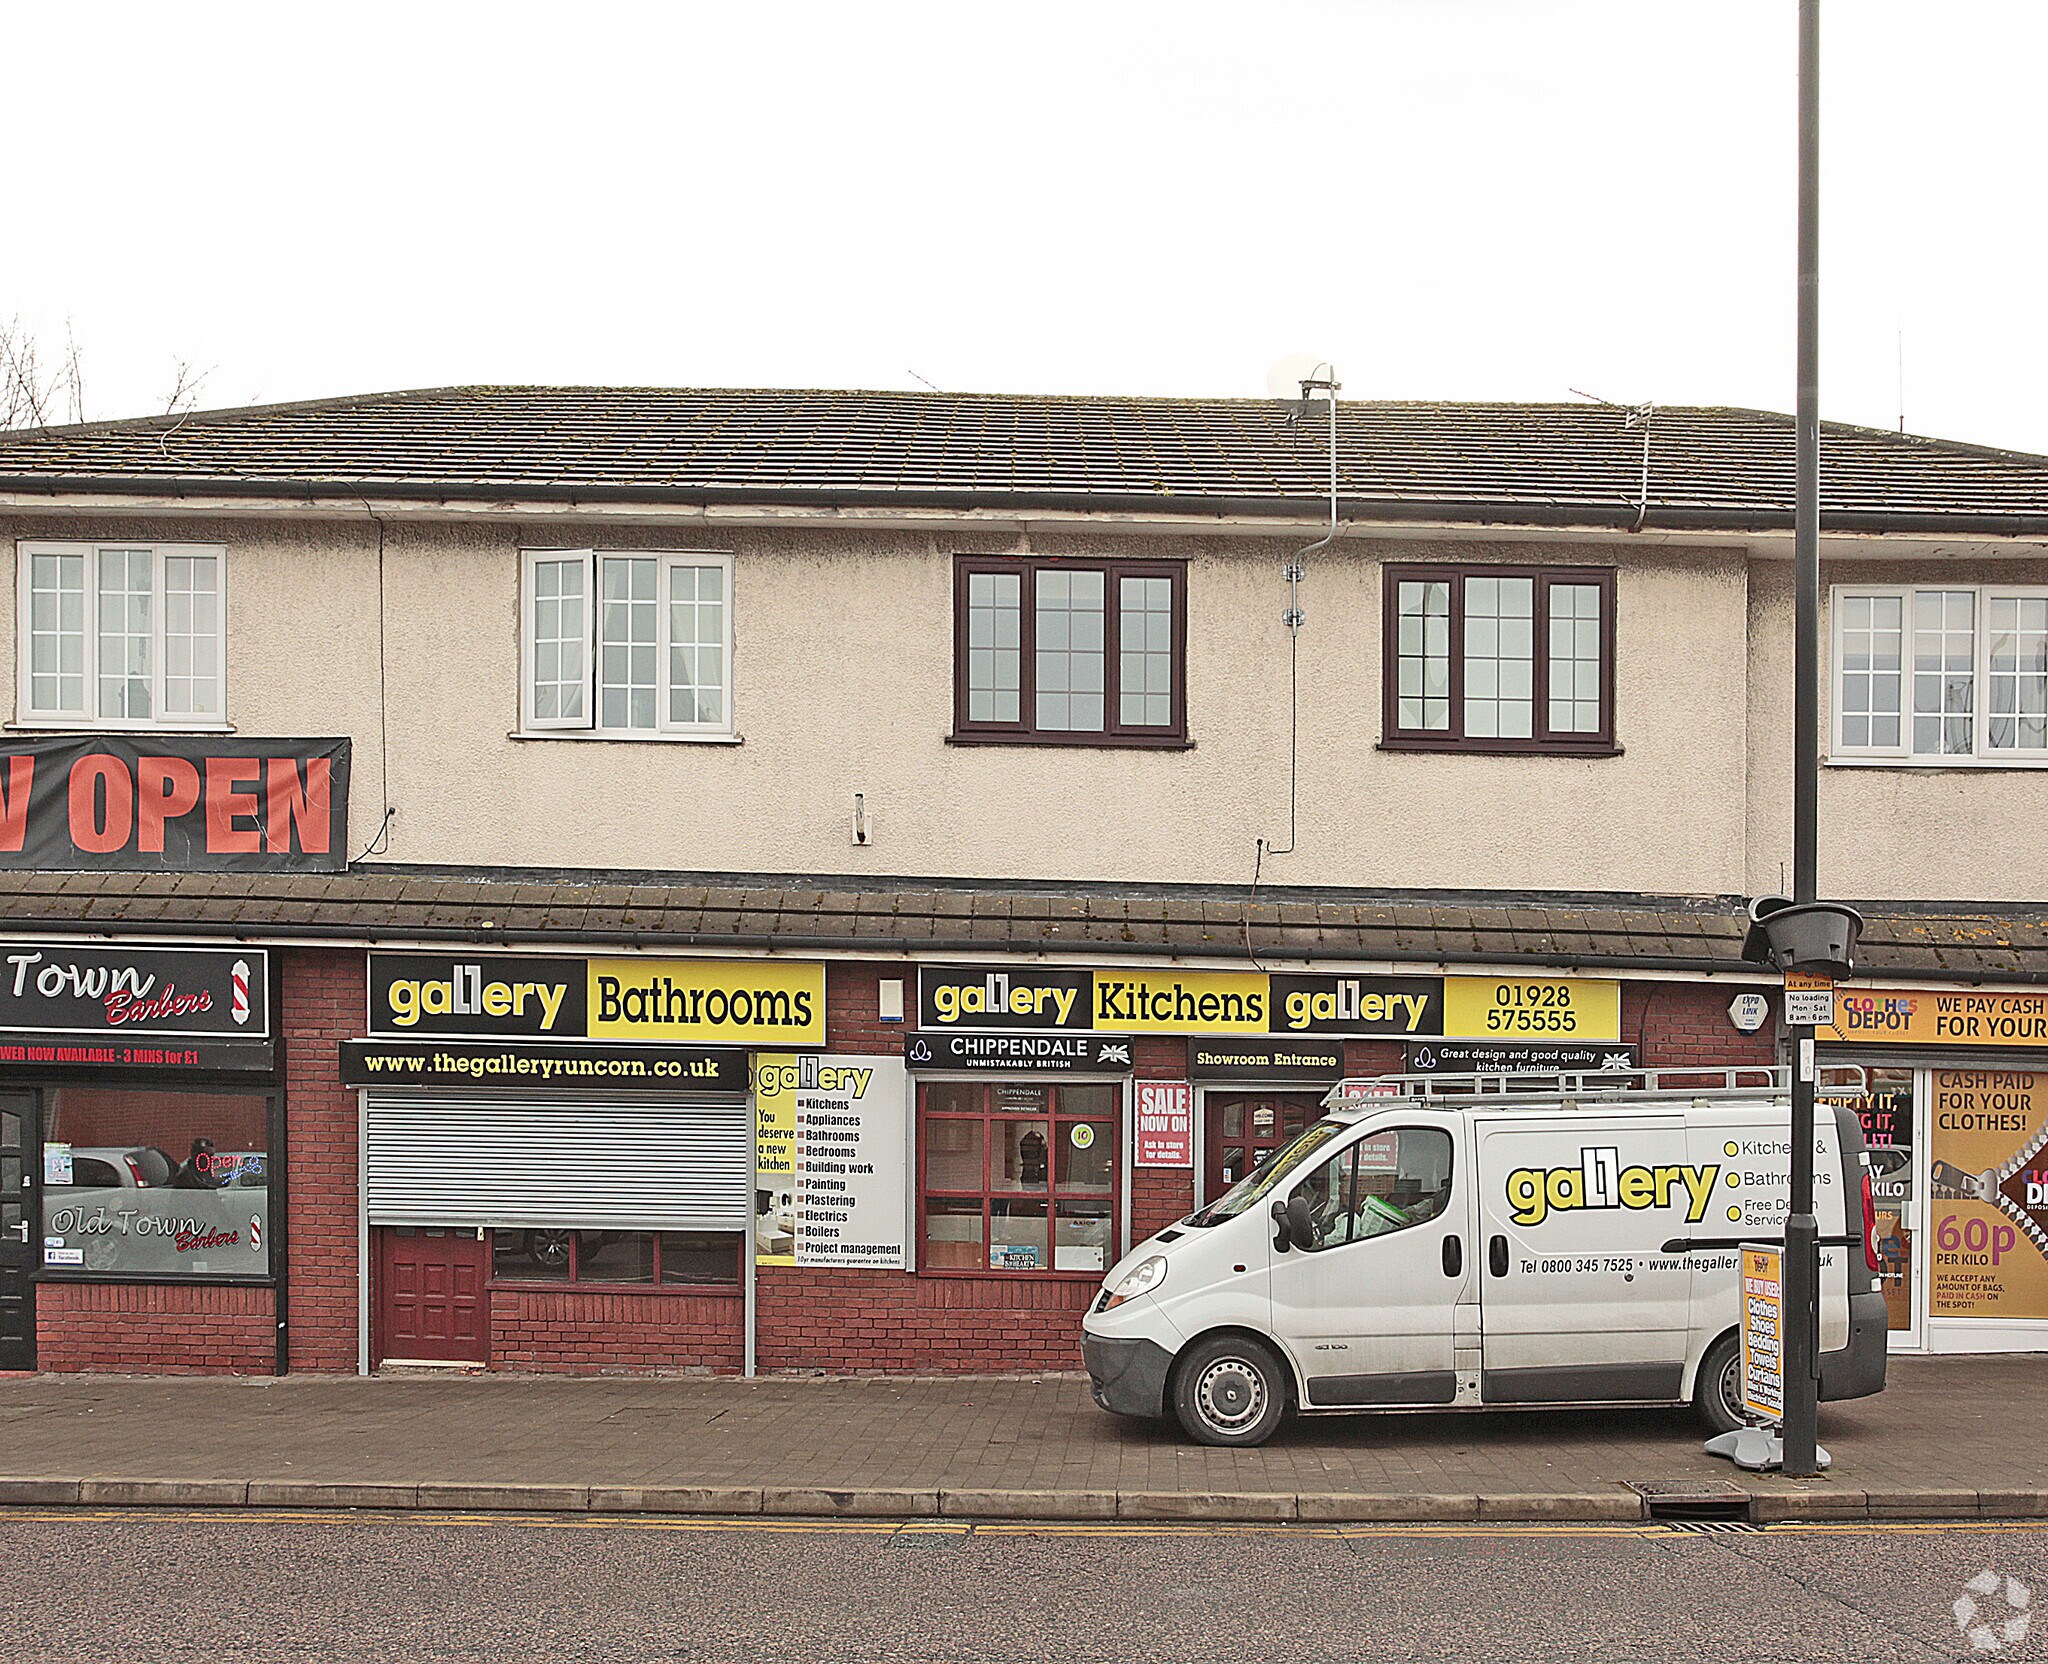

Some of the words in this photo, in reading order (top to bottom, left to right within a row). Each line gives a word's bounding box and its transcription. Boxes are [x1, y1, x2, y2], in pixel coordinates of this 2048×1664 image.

[68, 753, 331, 853] OPEN
[7, 951, 155, 999] Town
[104, 982, 213, 1026] Barbers
[389, 964, 567, 1030] gallery
[598, 976, 812, 1027] Bathrooms
[934, 973, 1078, 1025] gallery
[1098, 983, 1263, 1022] Kitchens
[1496, 985, 1570, 1008] 01928
[1742, 996, 1760, 1006] EXPO
[1802, 994, 1829, 1002] loading
[1285, 980, 1428, 1032] gallery
[1742, 1008, 1759, 1016] LINK
[1937, 997, 1962, 1013] WE
[1966, 998, 1996, 1013] PAY
[2001, 999, 2044, 1014] CASH
[1486, 1009, 1577, 1032] 575555
[1848, 1011, 1914, 1030] DEPOT
[1937, 1016, 1979, 1036] FOR
[1986, 1017, 2047, 1038] YOUR
[0, 1046, 25, 1061] WER
[28, 1047, 55, 1061] NOW
[57, 1047, 115, 1063] AVAILABLE
[124, 1049, 131, 1063] 3
[134, 1049, 163, 1064] MINS
[165, 1050, 182, 1064] for
[184, 1050, 199, 1064] £1
[950, 1038, 1088, 1057] CHIPPENDALE
[1440, 1048, 1469, 1059] Great
[1472, 1049, 1506, 1061] design
[1509, 1049, 1529, 1060] and
[1531, 1050, 1558, 1061] good
[1561, 1050, 1596, 1062] quality
[364, 1053, 719, 1078] www.thegalleryruncorn.co.uk
[966, 1058, 1033, 1068] UNMISTAKABLY
[1036, 1059, 1071, 1069] BRITISH
[1197, 1052, 1270, 1066] Showroom
[1274, 1053, 1337, 1066] Entrance
[1476, 1062, 1513, 1072] kitchen
[1516, 1062, 1560, 1073] furniture
[759, 1056, 873, 1099] gallery
[1939, 1072, 1987, 1088] CASH
[1993, 1073, 2034, 1090] PAID
[996, 1088, 1042, 1096] CHIPPENDALE
[806, 1099, 849, 1110] Kitchens
[1141, 1088, 1186, 1115] SALE
[1879, 1094, 1898, 1111] IT,
[1939, 1093, 1975, 1109] FOR
[1980, 1093, 2031, 1110] YOUR
[758, 1109, 775, 1122] You
[806, 1115, 861, 1126] Appliances
[1877, 1114, 1895, 1131] IT,
[1939, 1113, 2026, 1131] CLOTHES!
[758, 1124, 795, 1139] deserve
[1140, 1116, 1168, 1132] NOW
[1171, 1116, 1188, 1132] ON
[806, 1130, 860, 1142] Bathrooms
[758, 1144, 764, 1154] a
[766, 1144, 787, 1154] new
[806, 1146, 856, 1158] Bedrooms
[1144, 1141, 1157, 1149] Ask
[1158, 1141, 1165, 1149] in
[1166, 1141, 1184, 1149] store
[1372, 1143, 1391, 1151] store
[1742, 1141, 1794, 1155] Kitche
[1815, 1140, 1828, 1154] &
[758, 1155, 790, 1170] kitchen
[1157, 1151, 1182, 1159] details.
[196, 1153, 244, 1177] Open
[806, 1162, 846, 1174] Building
[849, 1163, 874, 1174] work
[805, 1179, 846, 1191] Painting
[1506, 1146, 1721, 1226] gallery
[1871, 1183, 1905, 1197] KILO
[805, 1194, 856, 1207] Plastering
[1745, 1199, 1772, 1211] Free
[51, 1206, 113, 1236] Old
[118, 1209, 205, 1237] Town
[805, 1210, 848, 1222] Electrics
[175, 1226, 240, 1253] Barbers
[805, 1226, 840, 1237] Boilers
[805, 1242, 838, 1254] Project
[840, 1244, 901, 1255] management
[1937, 1215, 2016, 1266] 60p
[810, 1256, 846, 1264] manufacturers
[1520, 1259, 1537, 1274] Tel
[1541, 1259, 1572, 1274] 0800
[1575, 1259, 1599, 1273] 345
[1603, 1258, 1634, 1273] 7525
[1937, 1253, 1959, 1265] PER
[1961, 1254, 1989, 1266] KILO
[1937, 1274, 1948, 1282] WE
[1950, 1274, 1978, 1282] ACCEPT
[1936, 1283, 1969, 1291] AMOUNT
[1971, 1283, 1981, 1291] OF
[1965, 1292, 1985, 1300] CASH
[1747, 1296, 1778, 1320] Clothes
[1953, 1301, 1975, 1309] SPOT!
[1750, 1314, 1776, 1336] Shoes
[1747, 1330, 1779, 1357] Bedding
[1750, 1349, 1777, 1371] Towels
[1747, 1363, 1781, 1389] Curtains
